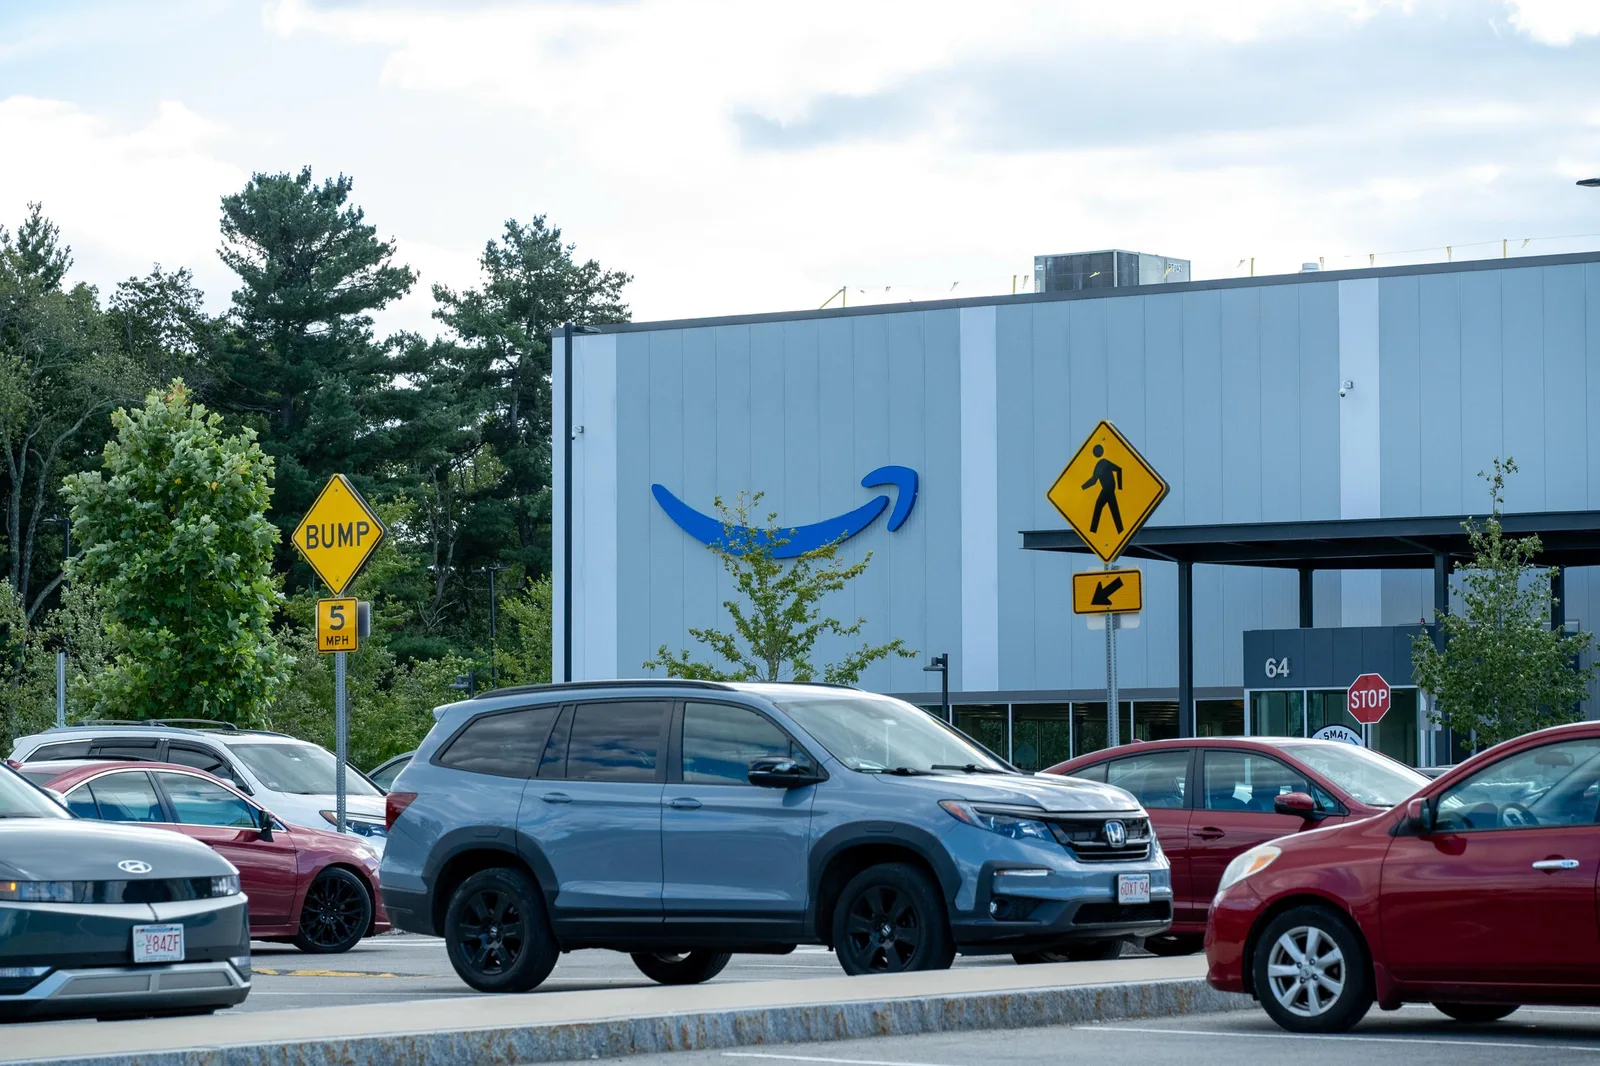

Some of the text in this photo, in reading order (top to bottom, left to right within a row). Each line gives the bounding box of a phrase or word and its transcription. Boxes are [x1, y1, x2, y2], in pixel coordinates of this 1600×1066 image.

[306, 521, 370, 549] BUMP
[329, 605, 345, 631] 5
[326, 635, 349, 646] MPH
[1265, 657, 1290, 678] 64
[1351, 689, 1388, 709] STOP
[1323, 729, 1348, 741] SMA1
